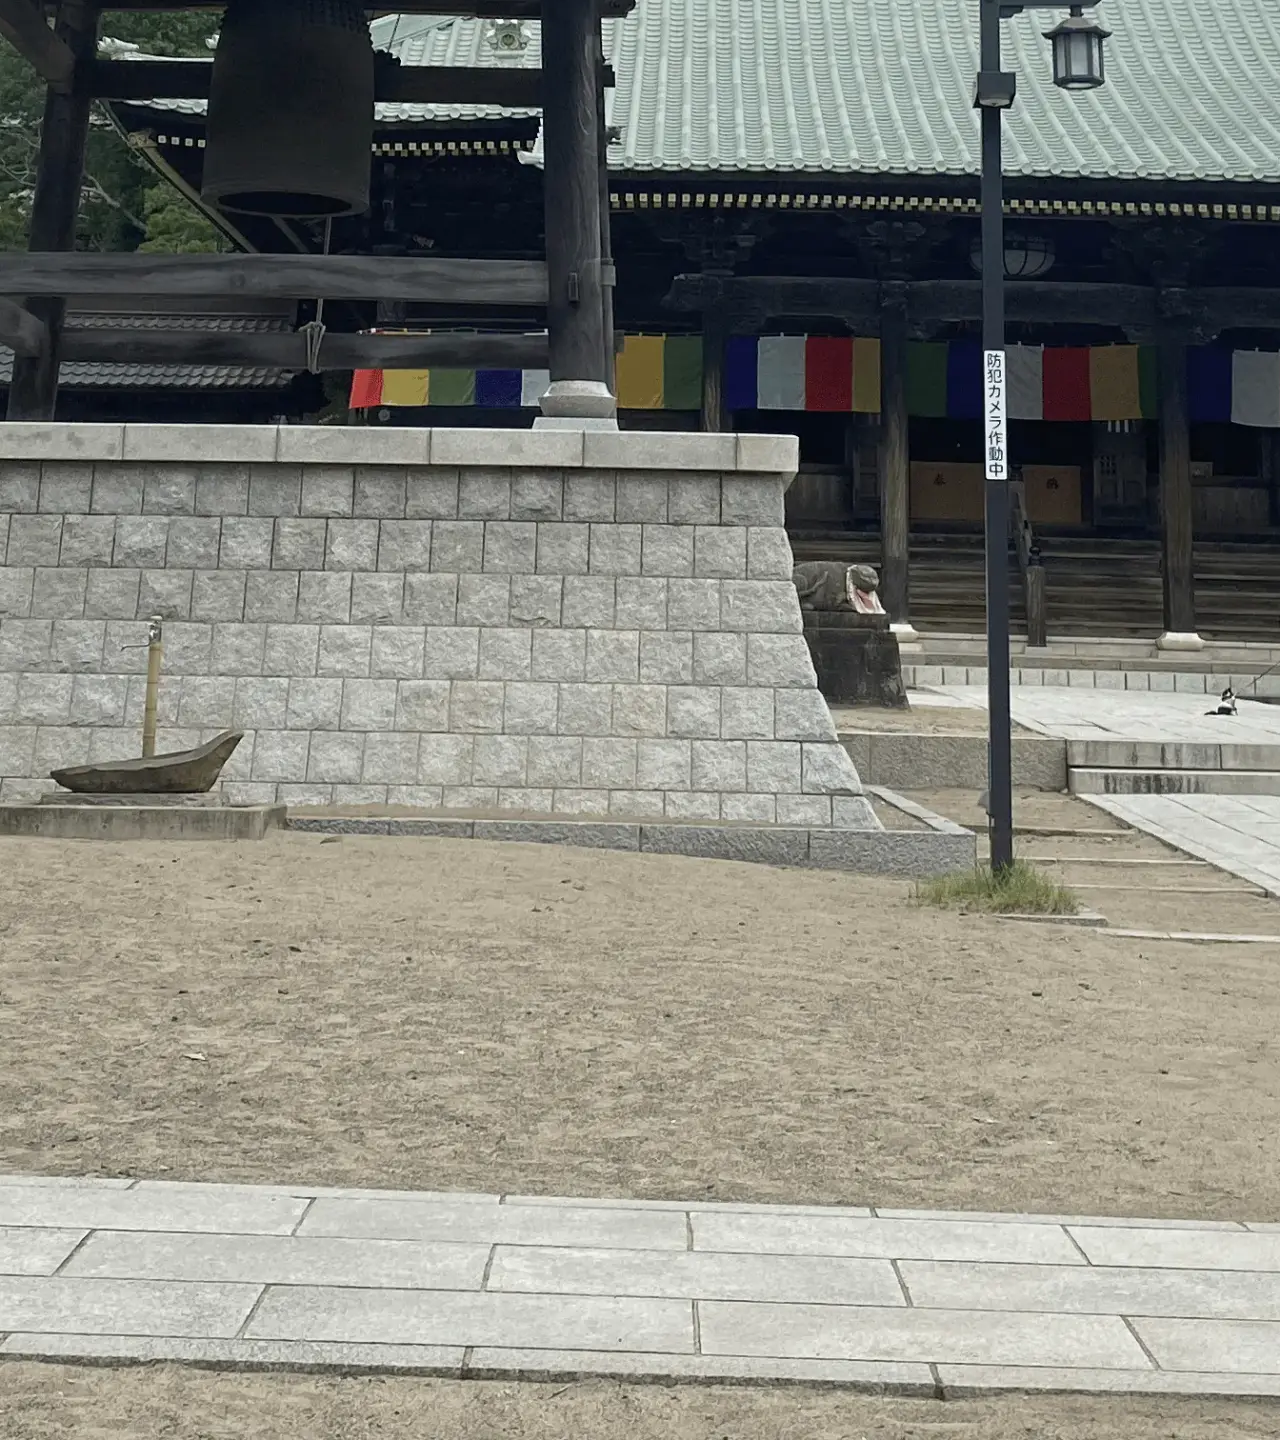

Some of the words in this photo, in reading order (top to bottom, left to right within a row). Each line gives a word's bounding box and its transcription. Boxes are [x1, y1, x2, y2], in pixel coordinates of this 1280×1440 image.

[987, 353, 1004, 477] 防犯カメラ作動中
